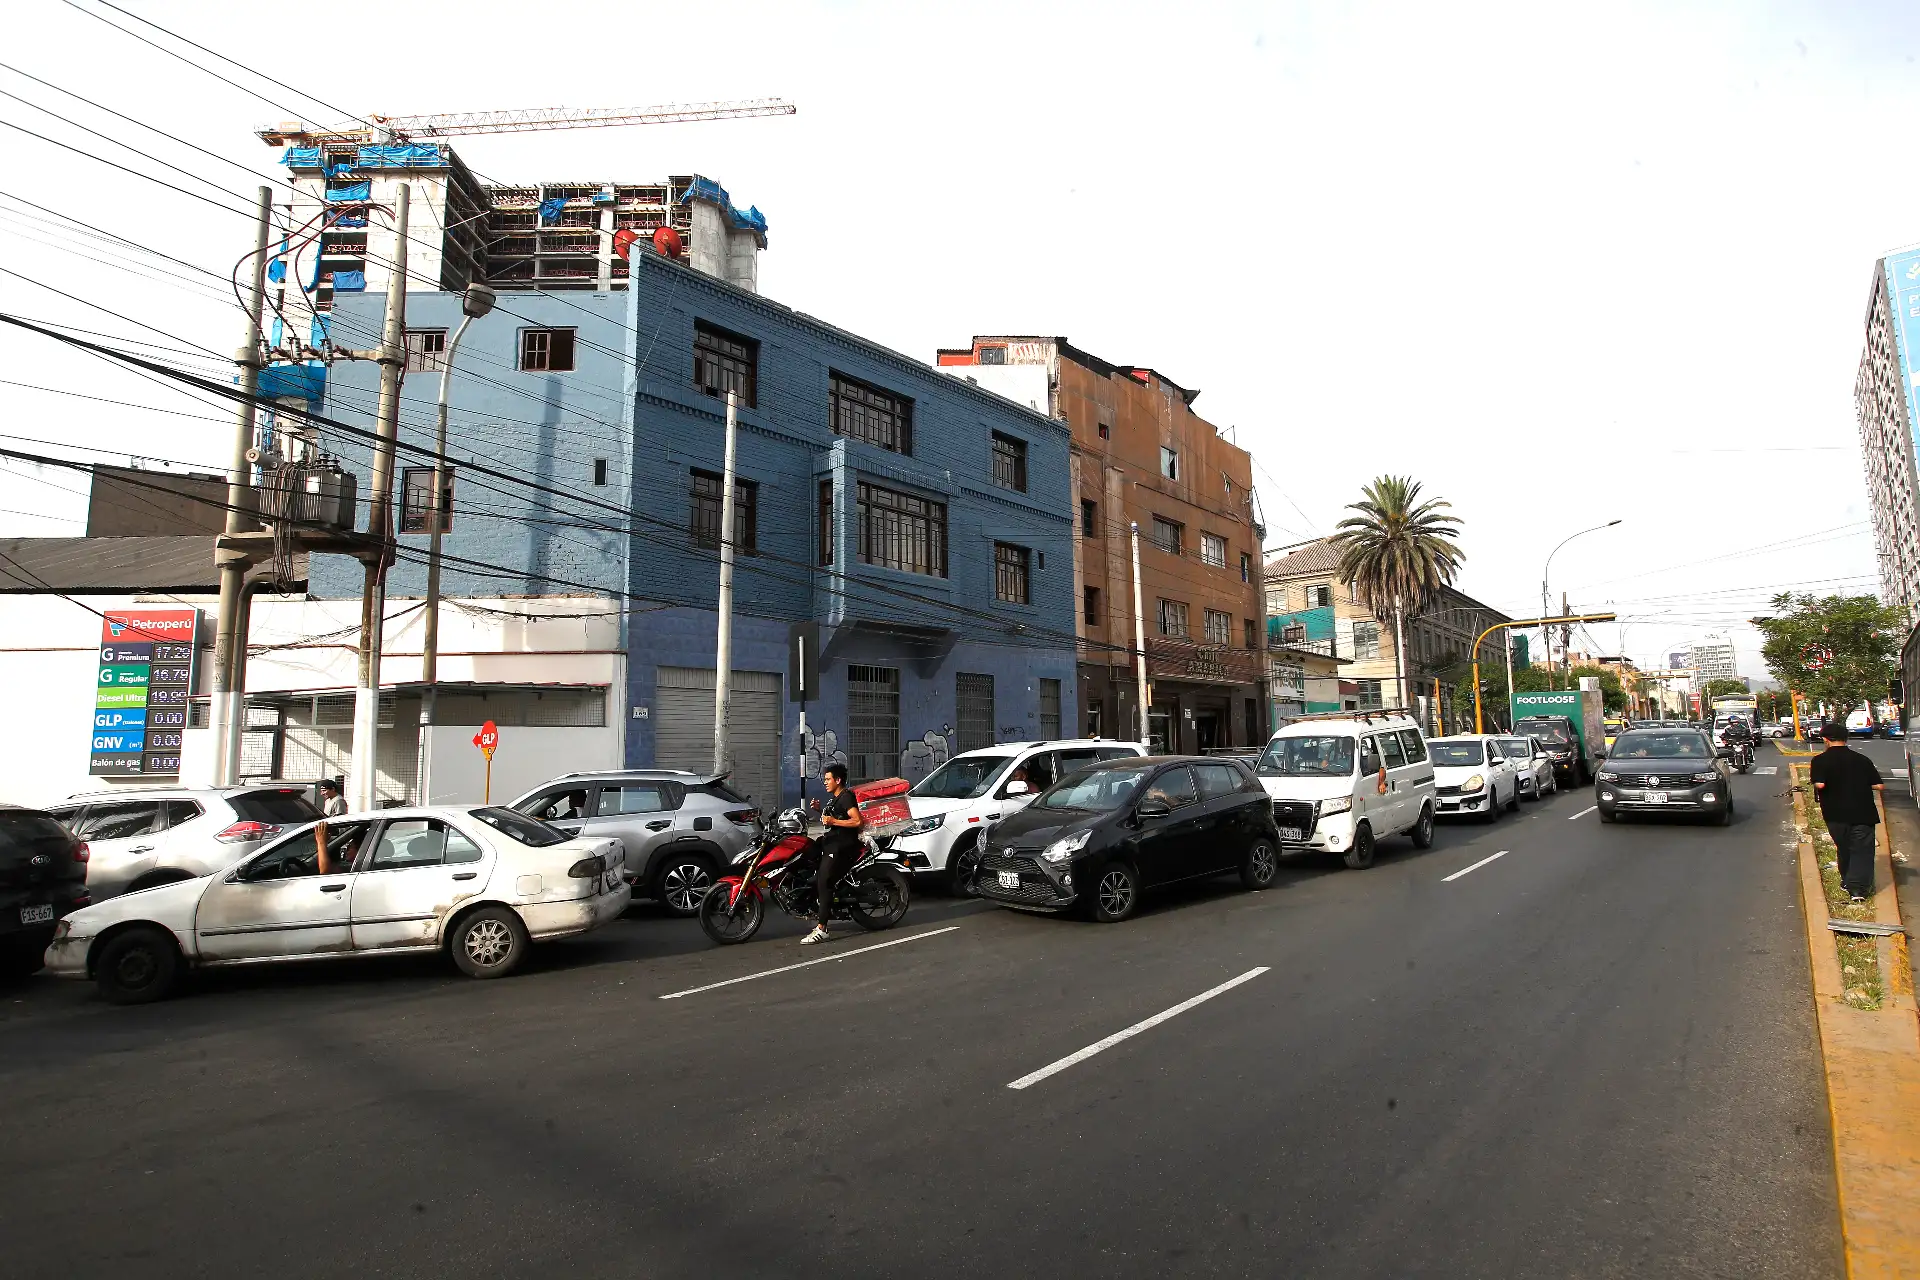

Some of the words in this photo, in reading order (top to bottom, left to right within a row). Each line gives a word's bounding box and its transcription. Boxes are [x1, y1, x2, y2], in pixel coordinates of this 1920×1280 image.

[132, 618, 192, 631] Petroperú
[101, 647, 114, 662] G
[100, 668, 113, 683] G
[119, 675, 149, 684] Regular
[153, 669, 188, 680] 16.79
[98, 693, 124, 702] Diesel
[125, 693, 146, 702] Ultra
[1517, 696, 1575, 704] FOOTLOOSE
[95, 714, 122, 727] GLP
[154, 712, 183, 724] 0.00
[93, 736, 123, 749] GNV
[152, 734, 182, 746] 0.00
[482, 732, 496, 746] GLP
[91, 758, 114, 767] Balón
[115, 758, 126, 767] de
[126, 759, 141, 768] gas
[151, 757, 180, 769] 0.00
